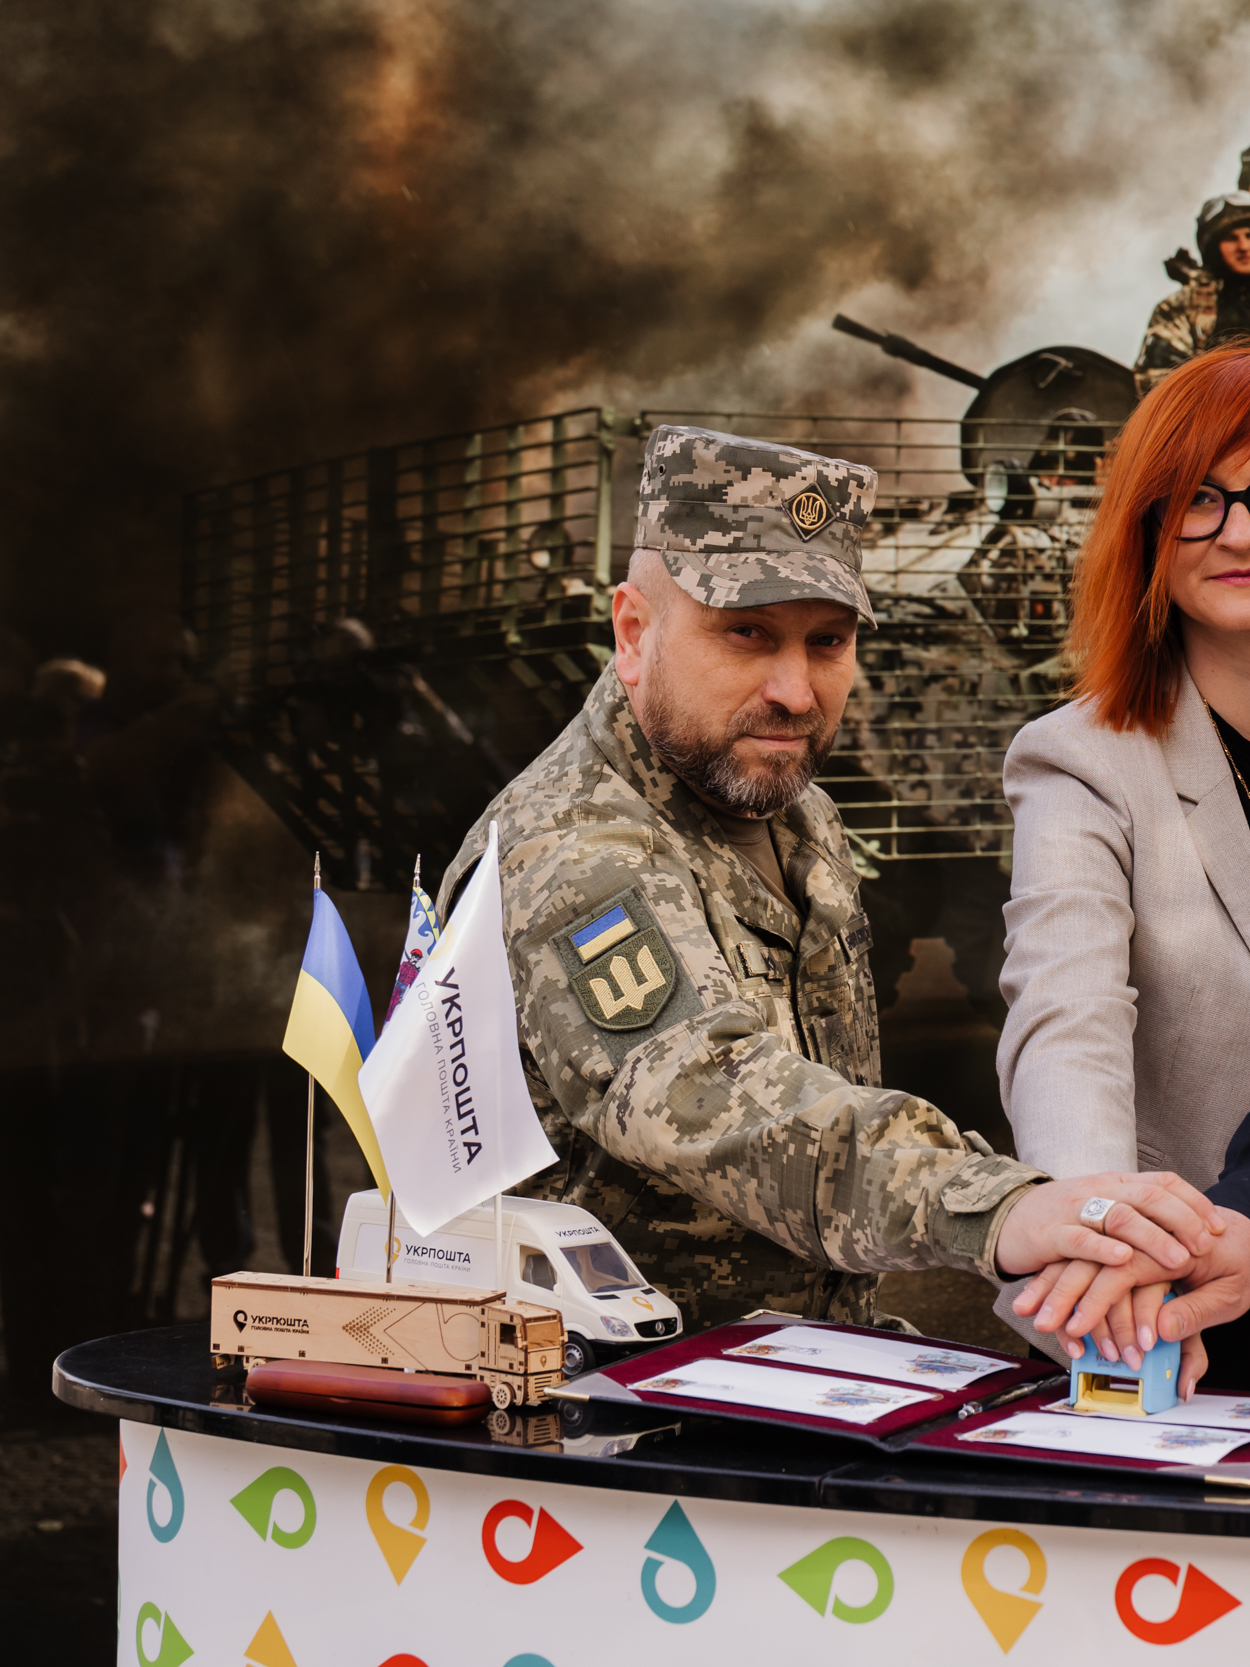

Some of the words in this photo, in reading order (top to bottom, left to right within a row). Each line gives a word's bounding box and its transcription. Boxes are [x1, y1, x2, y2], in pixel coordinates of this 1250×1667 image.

[434, 966, 483, 1166] УКРПОШТА
[416, 981, 444, 1055] ГОЛОВНА
[437, 1059, 451, 1115] ПОШТА
[444, 1118, 462, 1174] КРАЇНИ
[555, 1226, 600, 1238] УКРПОШТА
[405, 1244, 471, 1264] УКРПОШТА
[404, 1257, 429, 1266] ГОЛОВНА
[430, 1261, 450, 1270] ПОШТА
[250, 1314, 309, 1328] УКРПОШТА
